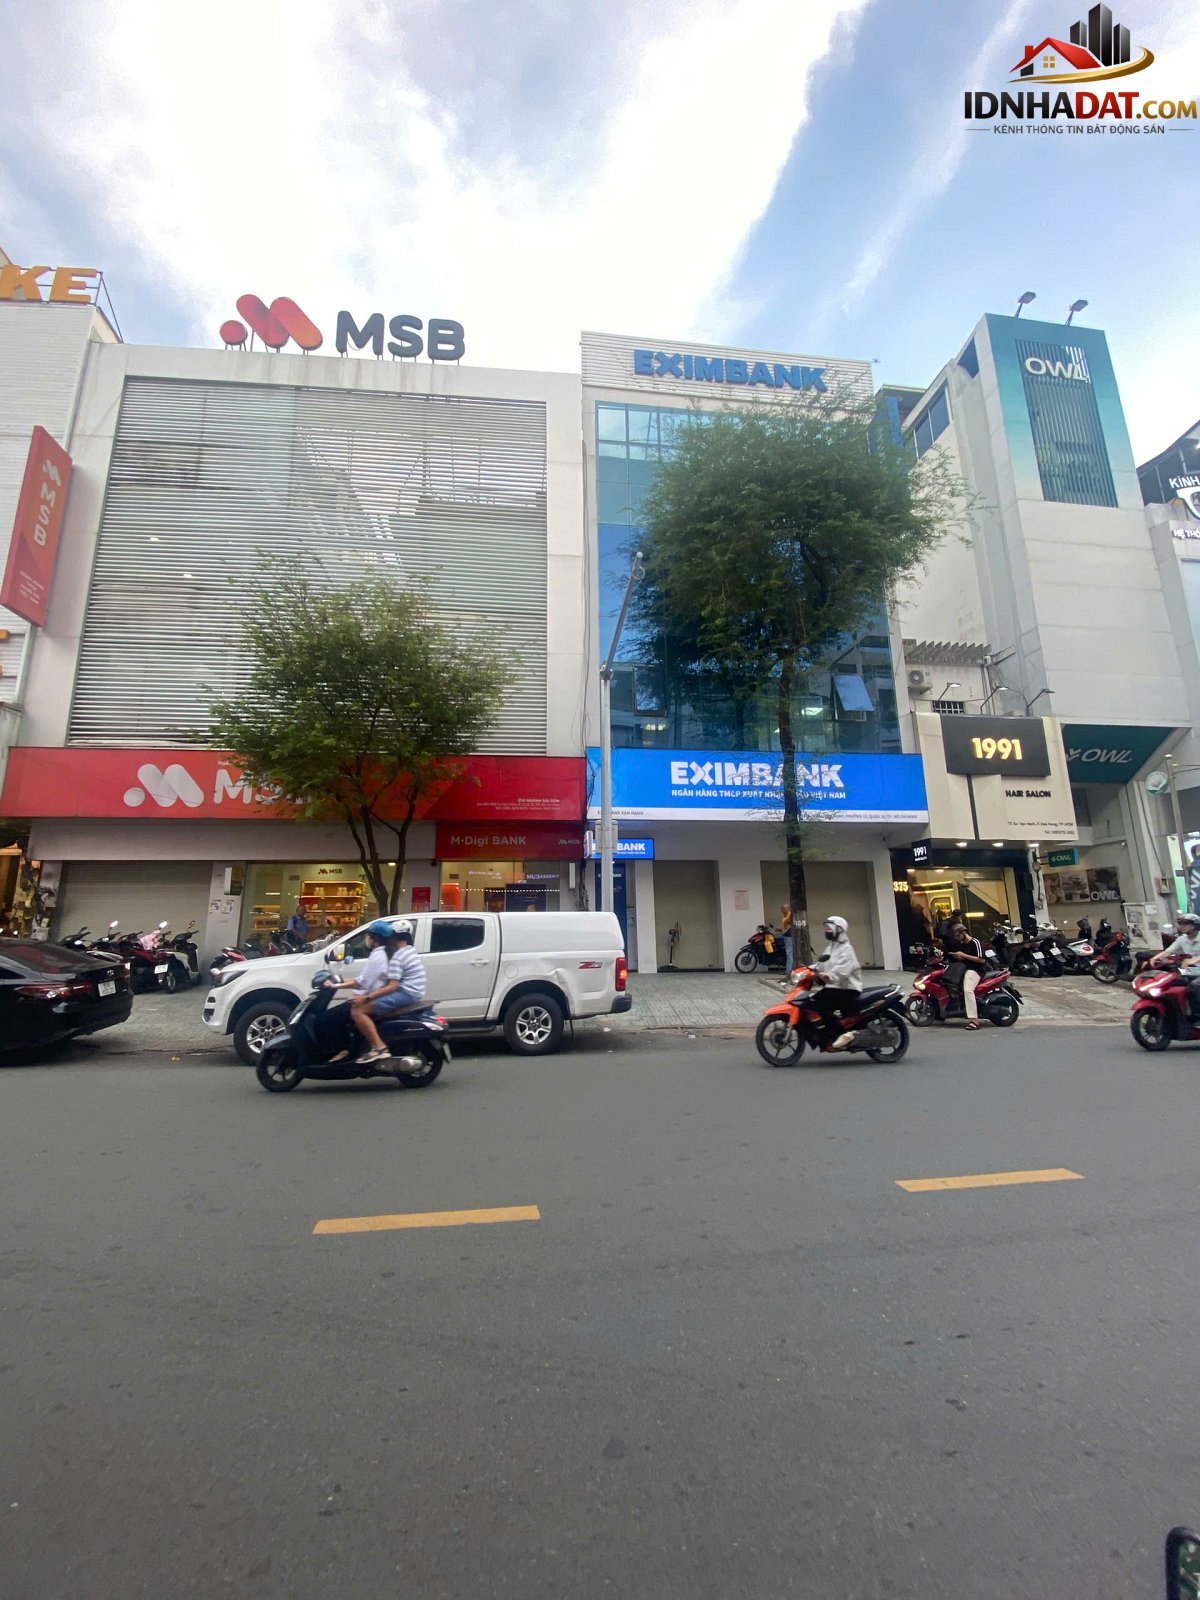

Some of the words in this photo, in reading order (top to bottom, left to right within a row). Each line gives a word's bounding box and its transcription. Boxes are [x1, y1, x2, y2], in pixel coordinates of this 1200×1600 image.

[336, 310, 466, 361] MSB
[633, 349, 828, 393] EXIMBANK
[34, 482, 57, 546] MSB
[971, 737, 1023, 760] 1991
[671, 788, 694, 797] NGÂN
[695, 788, 717, 798] HÀNG
[829, 792, 846, 800] NAM
[1005, 789, 1024, 798] HAIR
[1025, 790, 1052, 798] SALON
[492, 836, 527, 846] BANK
[914, 846, 927, 857] 1991
[893, 881, 909, 892] 375
